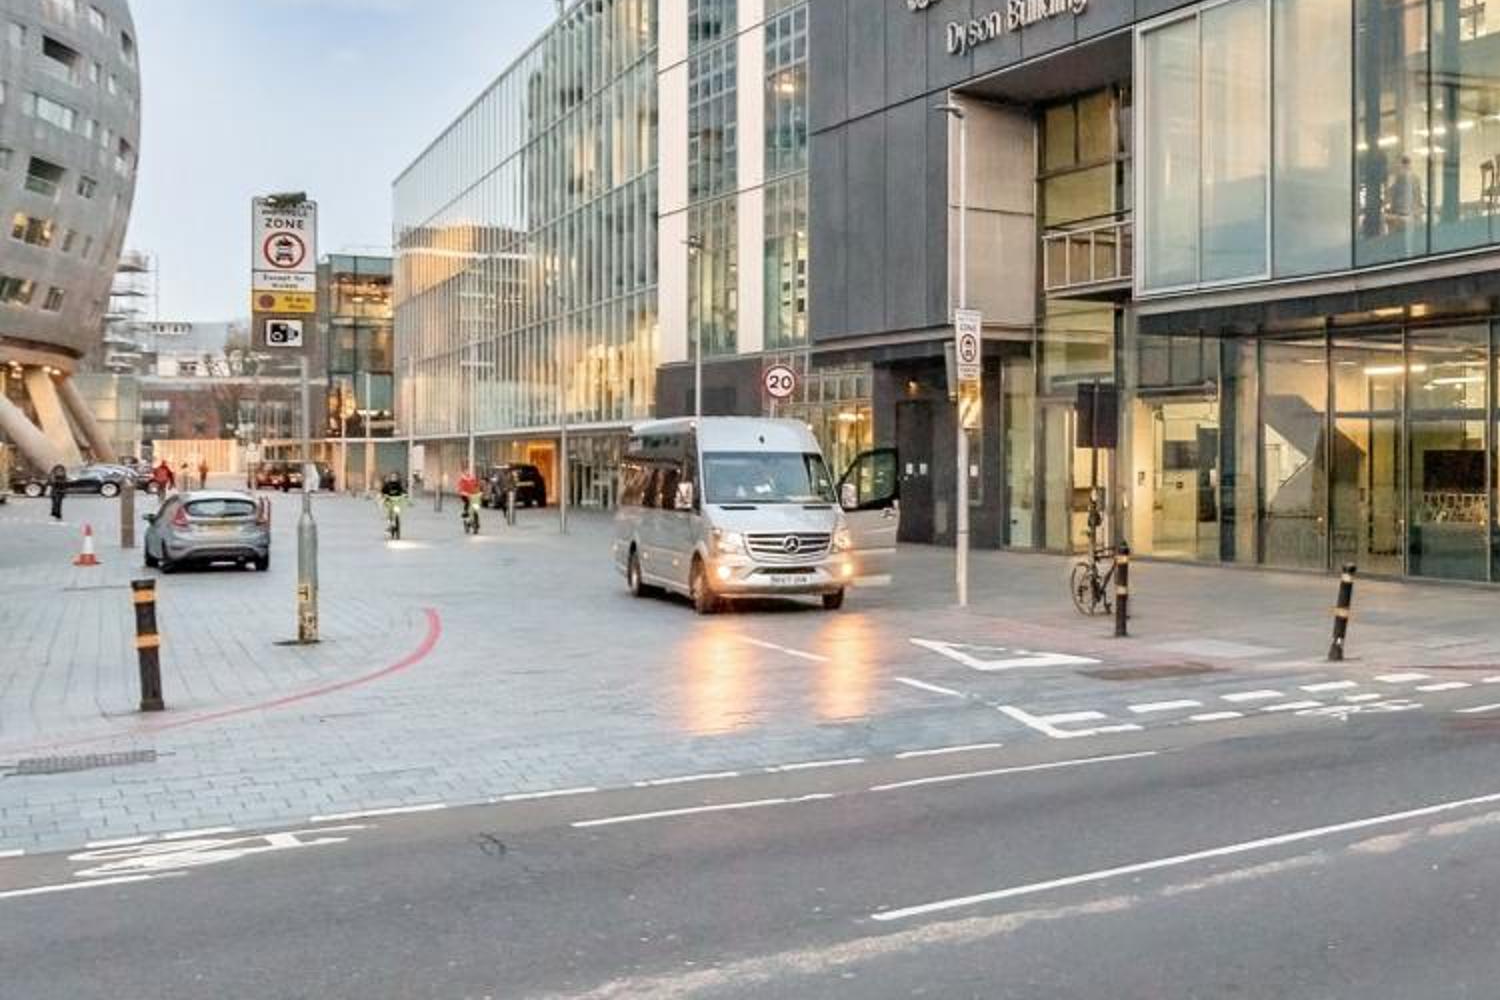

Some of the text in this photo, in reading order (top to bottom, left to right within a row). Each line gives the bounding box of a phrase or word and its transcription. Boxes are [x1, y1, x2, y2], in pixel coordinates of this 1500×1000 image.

[946, 10, 1001, 56] Dyson
[264, 217, 305, 230] ZONE
[768, 375, 793, 390] 20
